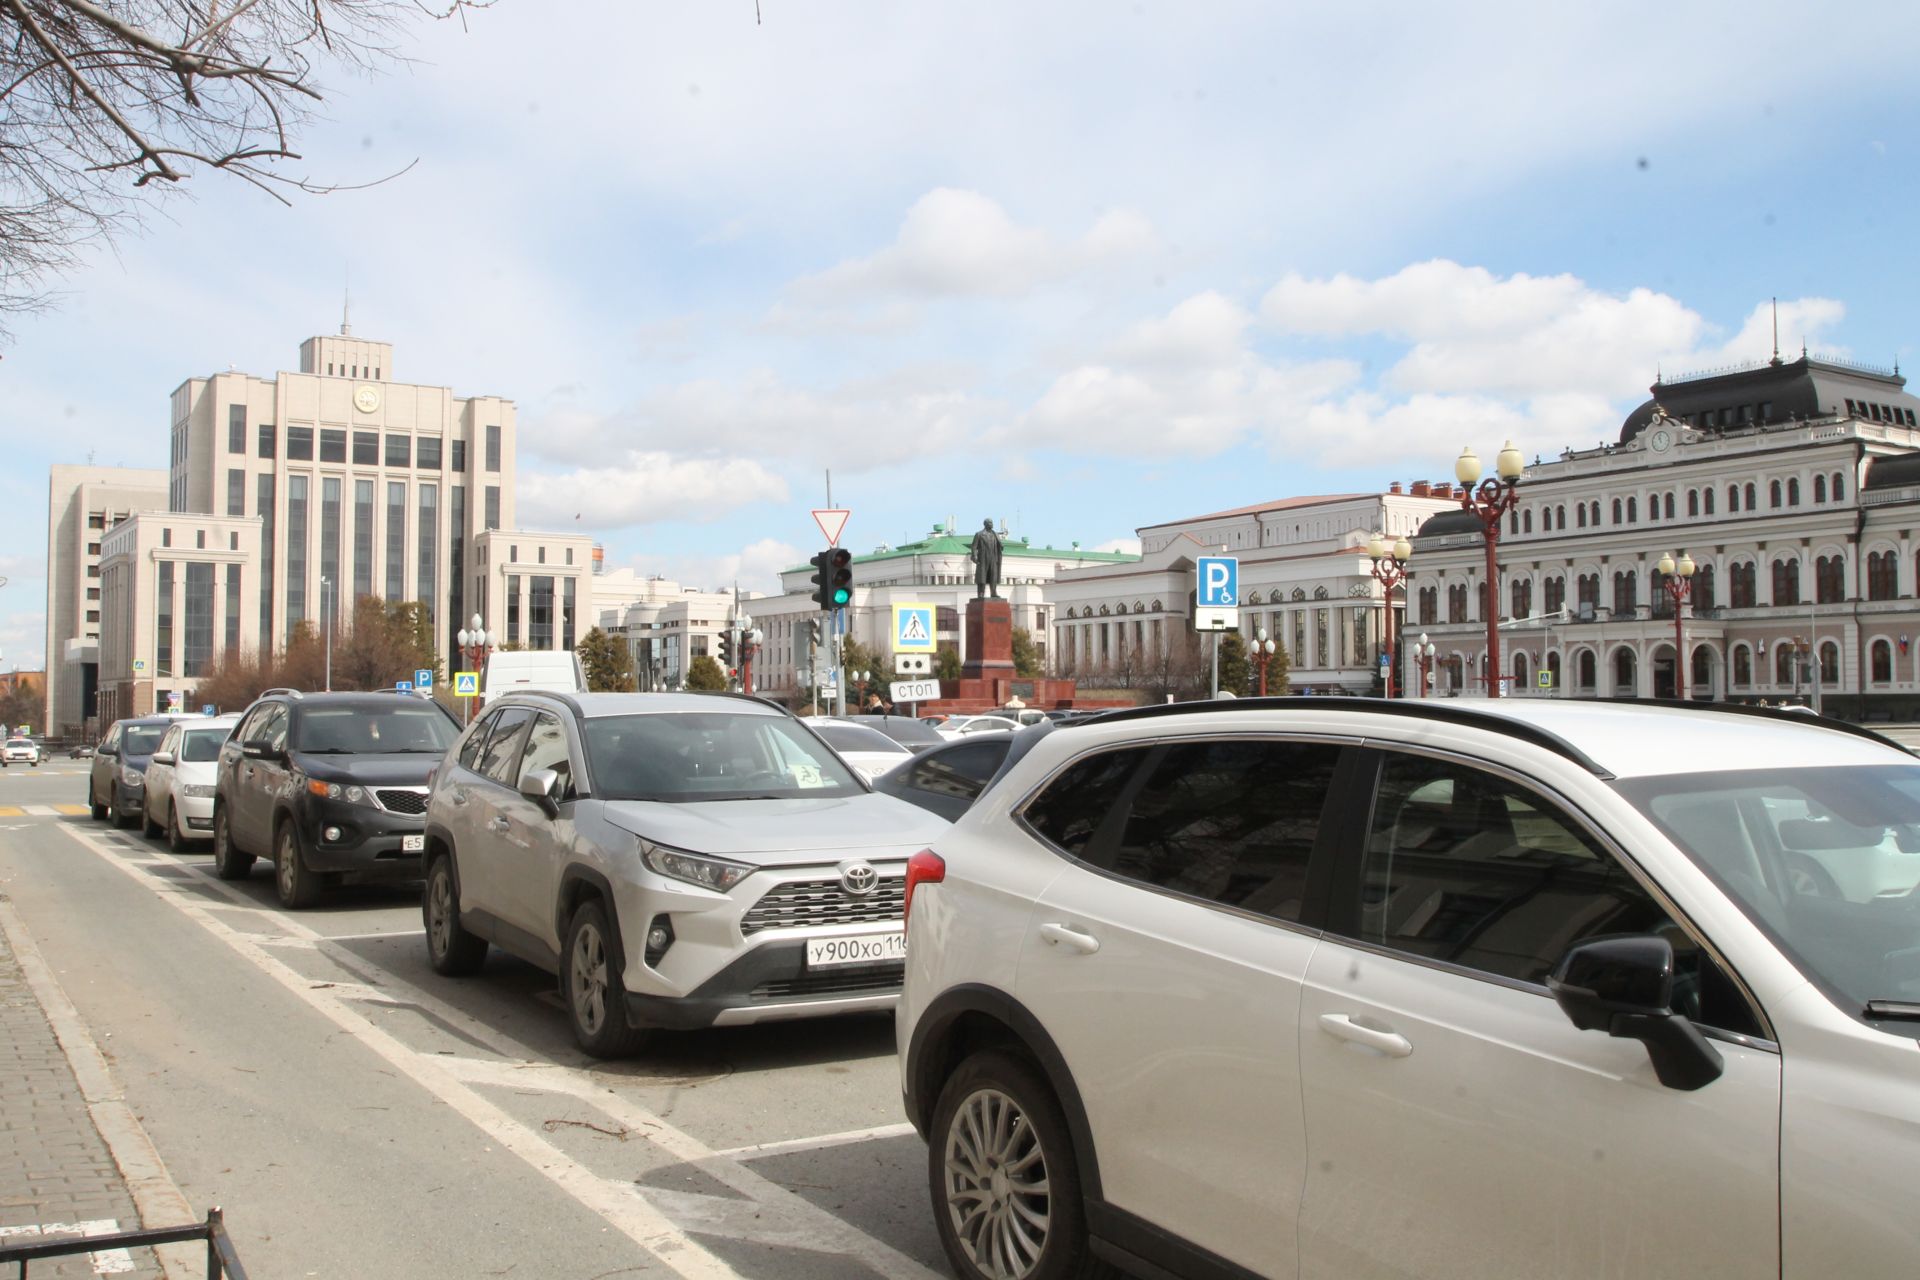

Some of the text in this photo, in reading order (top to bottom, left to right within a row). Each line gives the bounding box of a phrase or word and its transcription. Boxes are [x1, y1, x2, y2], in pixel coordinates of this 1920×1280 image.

[1207, 563, 1229, 602] P
[419, 672, 429, 686] P
[899, 683, 933, 698] СТОП
[815, 940, 883, 962] У900ХО
